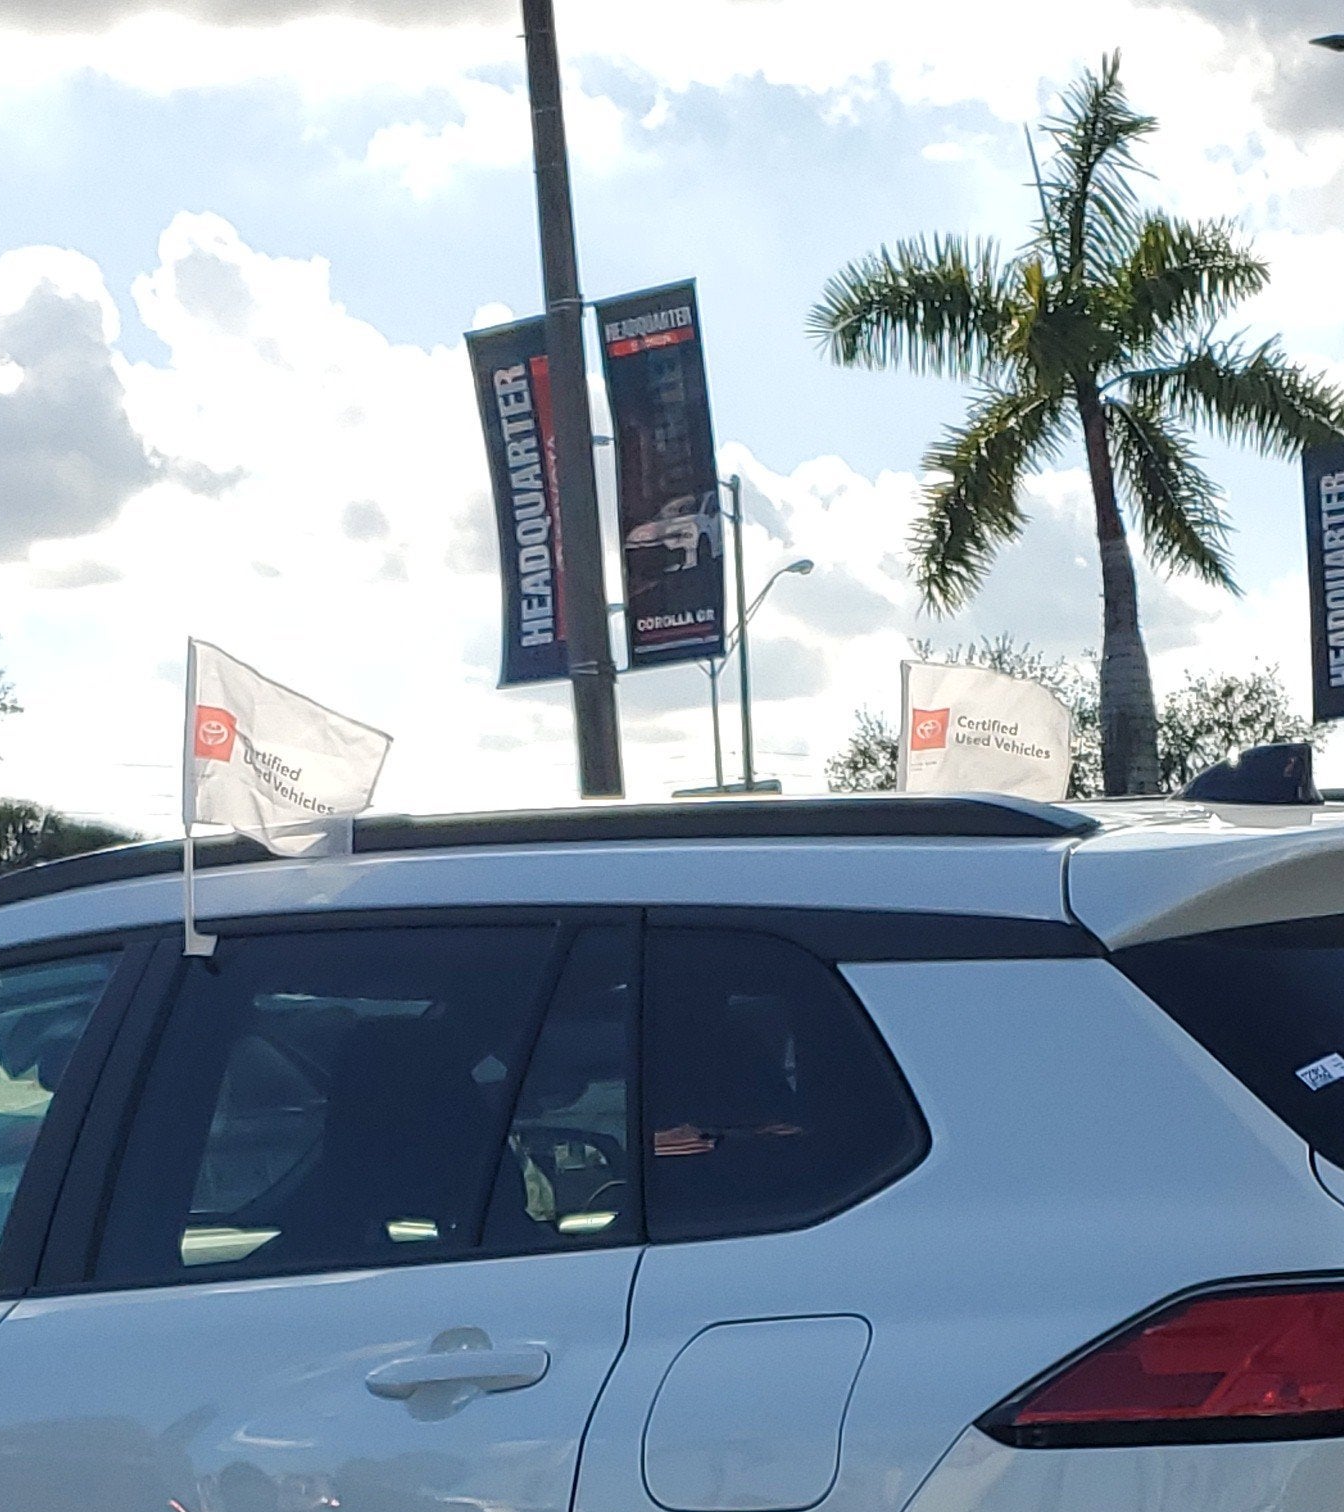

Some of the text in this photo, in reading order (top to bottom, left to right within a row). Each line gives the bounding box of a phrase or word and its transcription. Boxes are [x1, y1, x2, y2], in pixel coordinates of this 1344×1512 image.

[493, 362, 555, 647] HEADQUARTER
[637, 611, 695, 632] COROLLA
[956, 715, 1019, 737] Certified
[955, 732, 1051, 760] Used Vehicles
[273, 772, 336, 816] Vehicles
